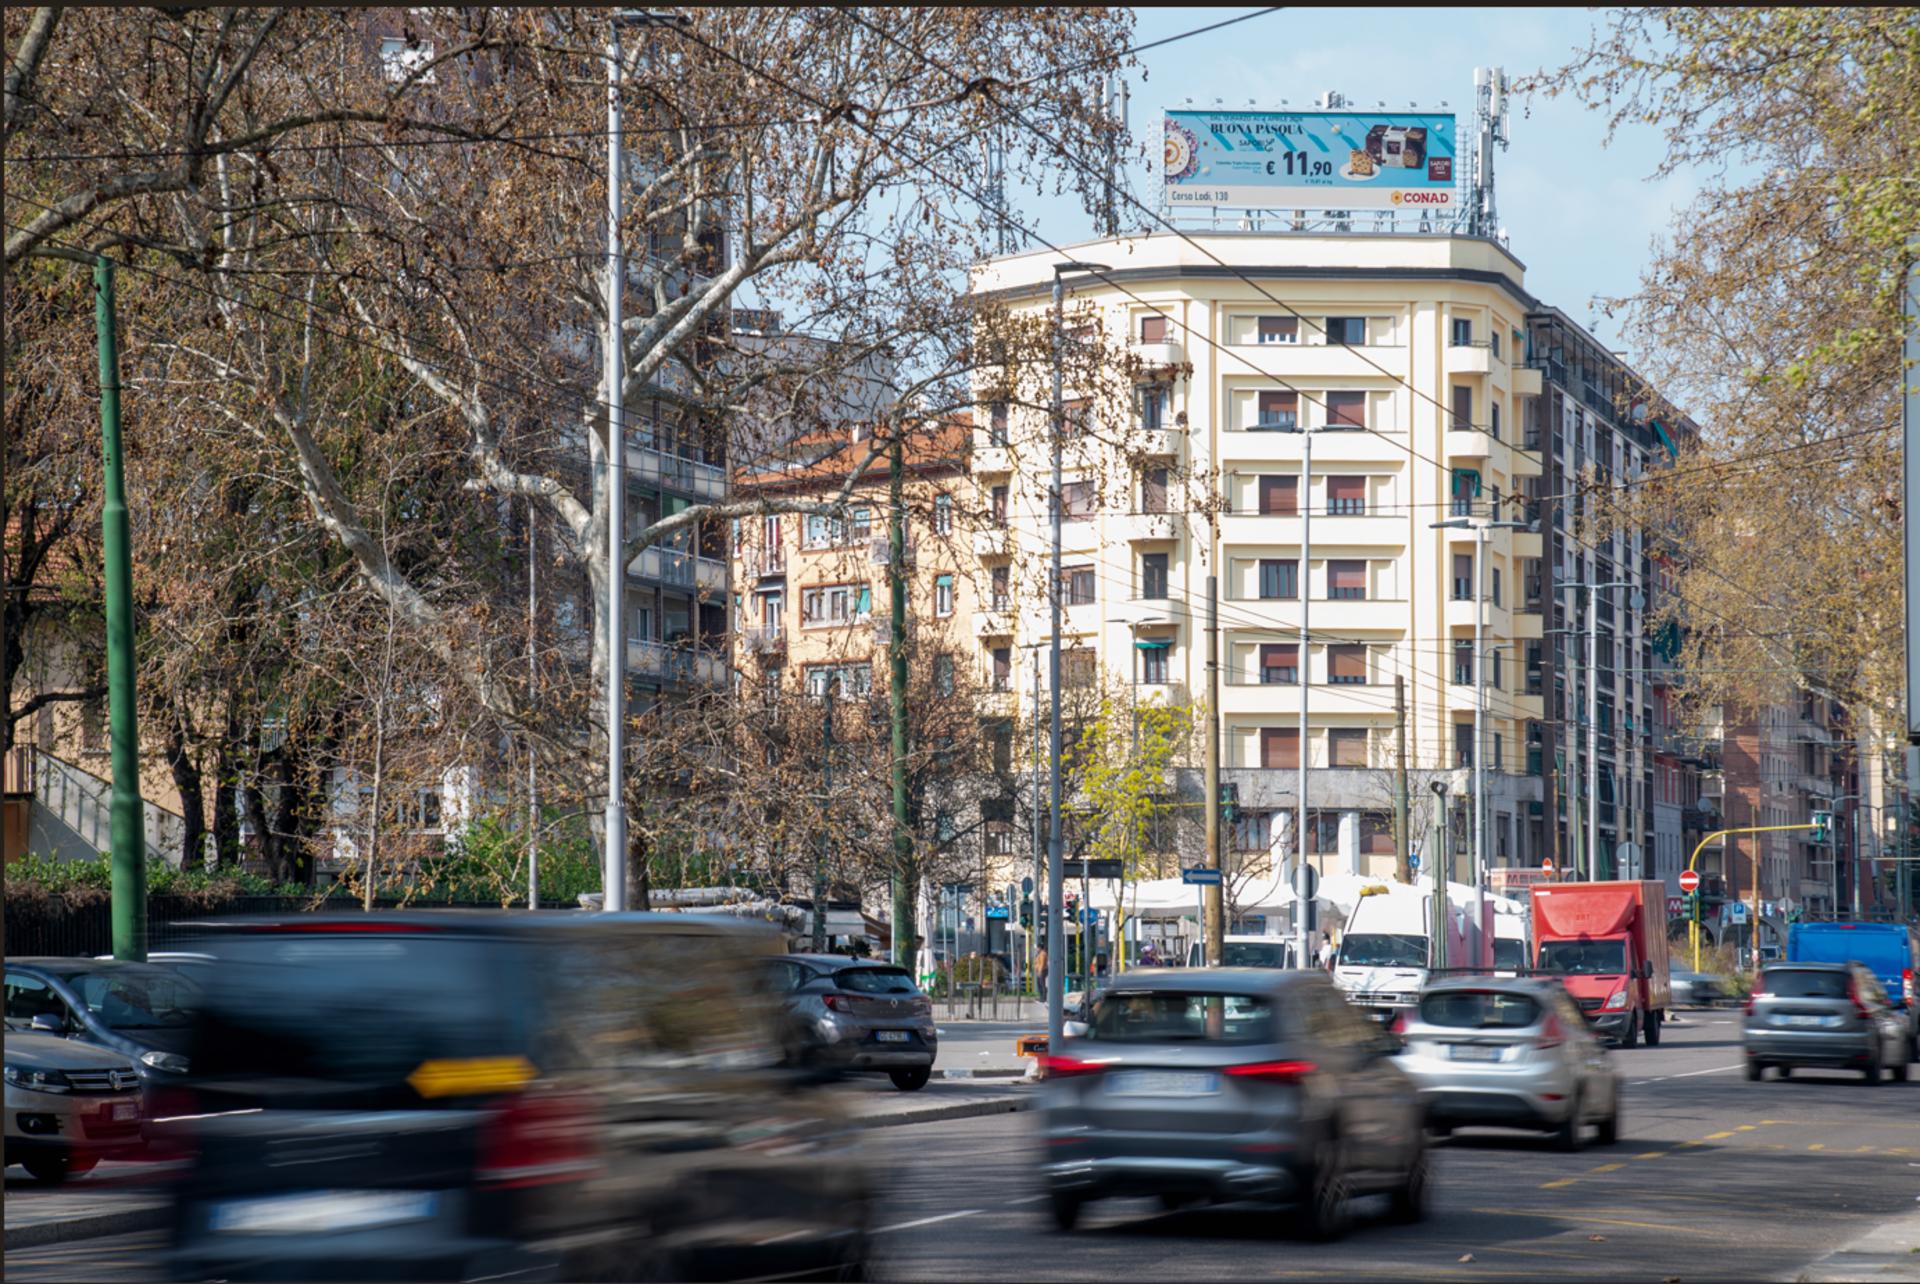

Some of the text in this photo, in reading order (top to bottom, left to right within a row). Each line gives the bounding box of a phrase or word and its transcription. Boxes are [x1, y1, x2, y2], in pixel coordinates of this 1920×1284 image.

[1210, 123, 1303, 136] BUONA PASQUA
[1266, 151, 1332, 177] € 11,90
[1171, 190, 1193, 201] Corso
[1403, 192, 1449, 204] CONAD
[1669, 900, 1683, 910] M
